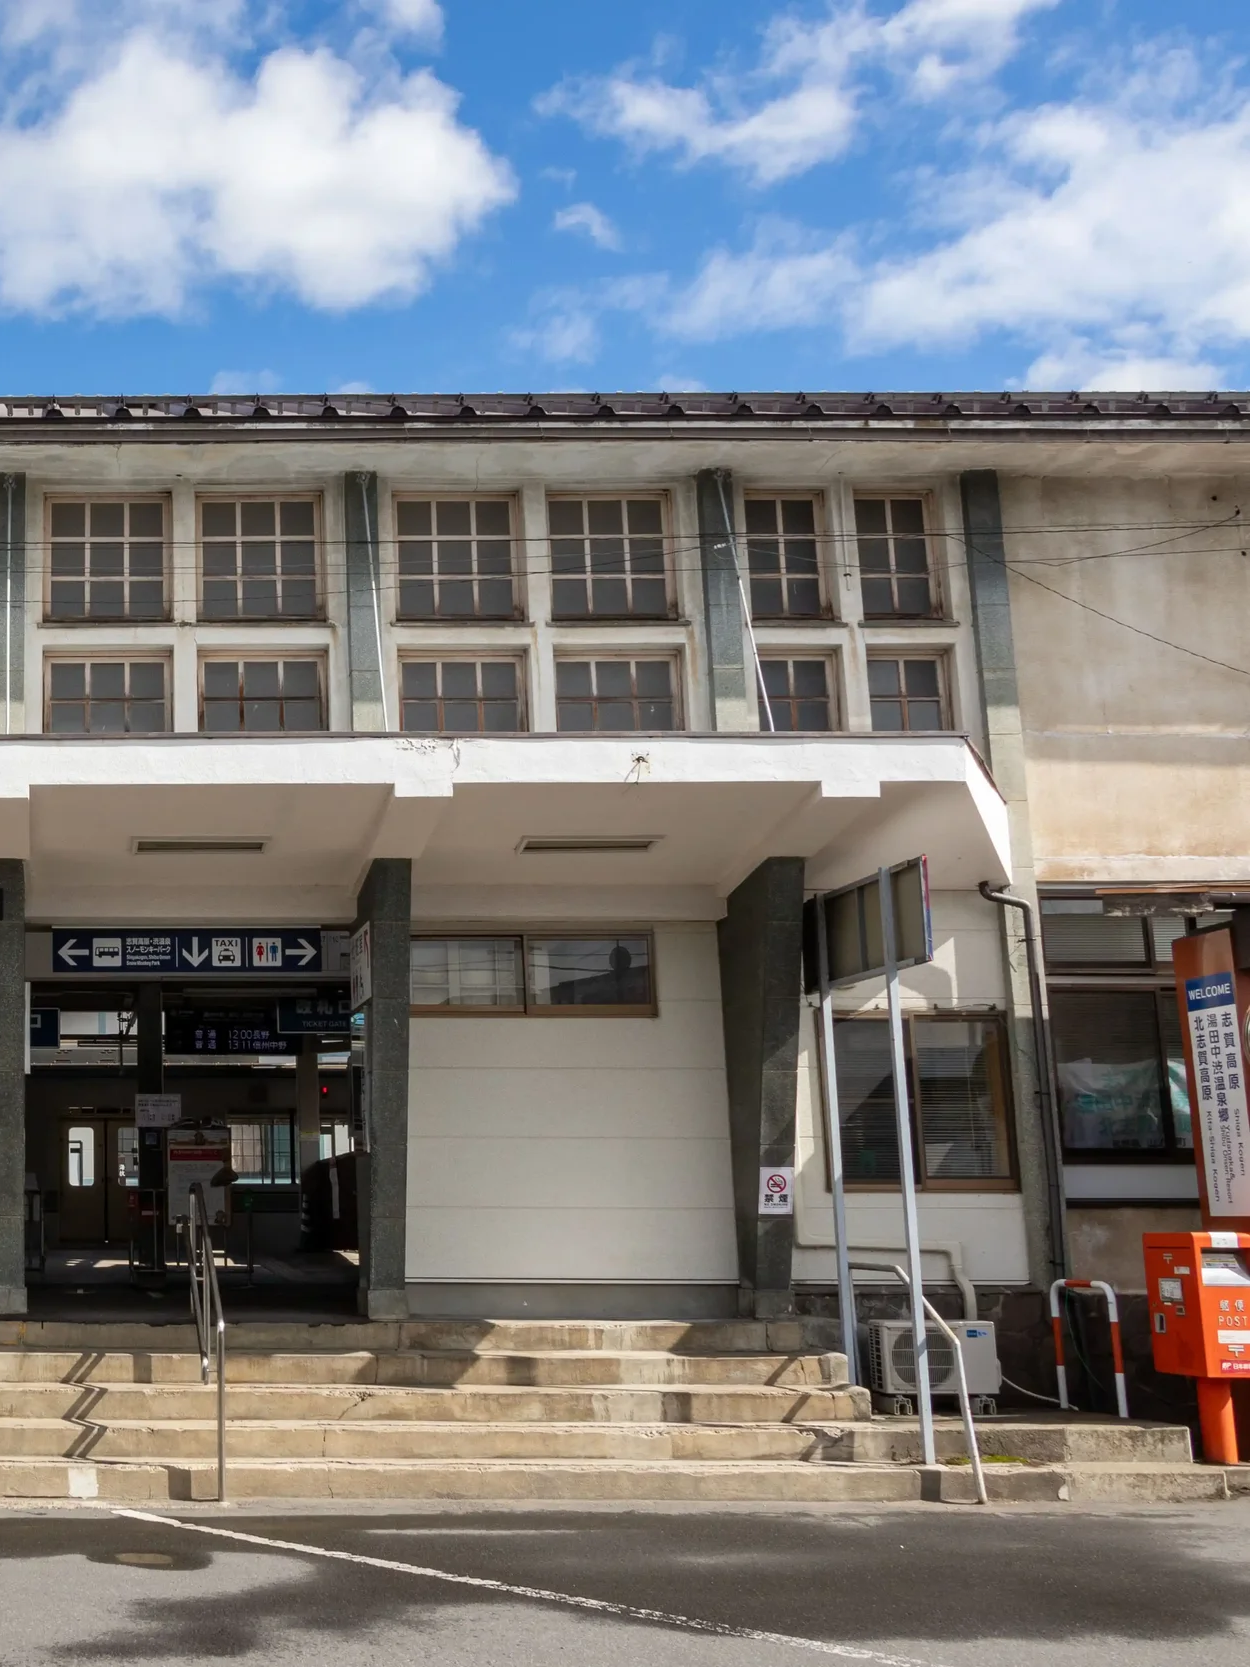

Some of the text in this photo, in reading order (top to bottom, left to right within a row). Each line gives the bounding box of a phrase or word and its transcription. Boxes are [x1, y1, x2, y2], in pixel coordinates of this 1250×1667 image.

[125, 946, 171, 954] スノーモンキーパーク
[214, 939, 239, 947] TAXI
[1188, 983, 1231, 1001] WELCOME
[302, 1019, 347, 1028] TICKET GATE
[1221, 1011, 1240, 1090] 志賀高原
[1193, 1016, 1213, 1101] 北志賀高原
[1206, 1013, 1230, 1123] 湯田中渋温泉郷
[1234, 1108, 1246, 1177] Shiga Kogen
[1213, 1168, 1221, 1202] Kogen
[764, 1194, 788, 1203] 禁煙
[1219, 1299, 1245, 1312] 郵便
[1218, 1315, 1248, 1327] POST
